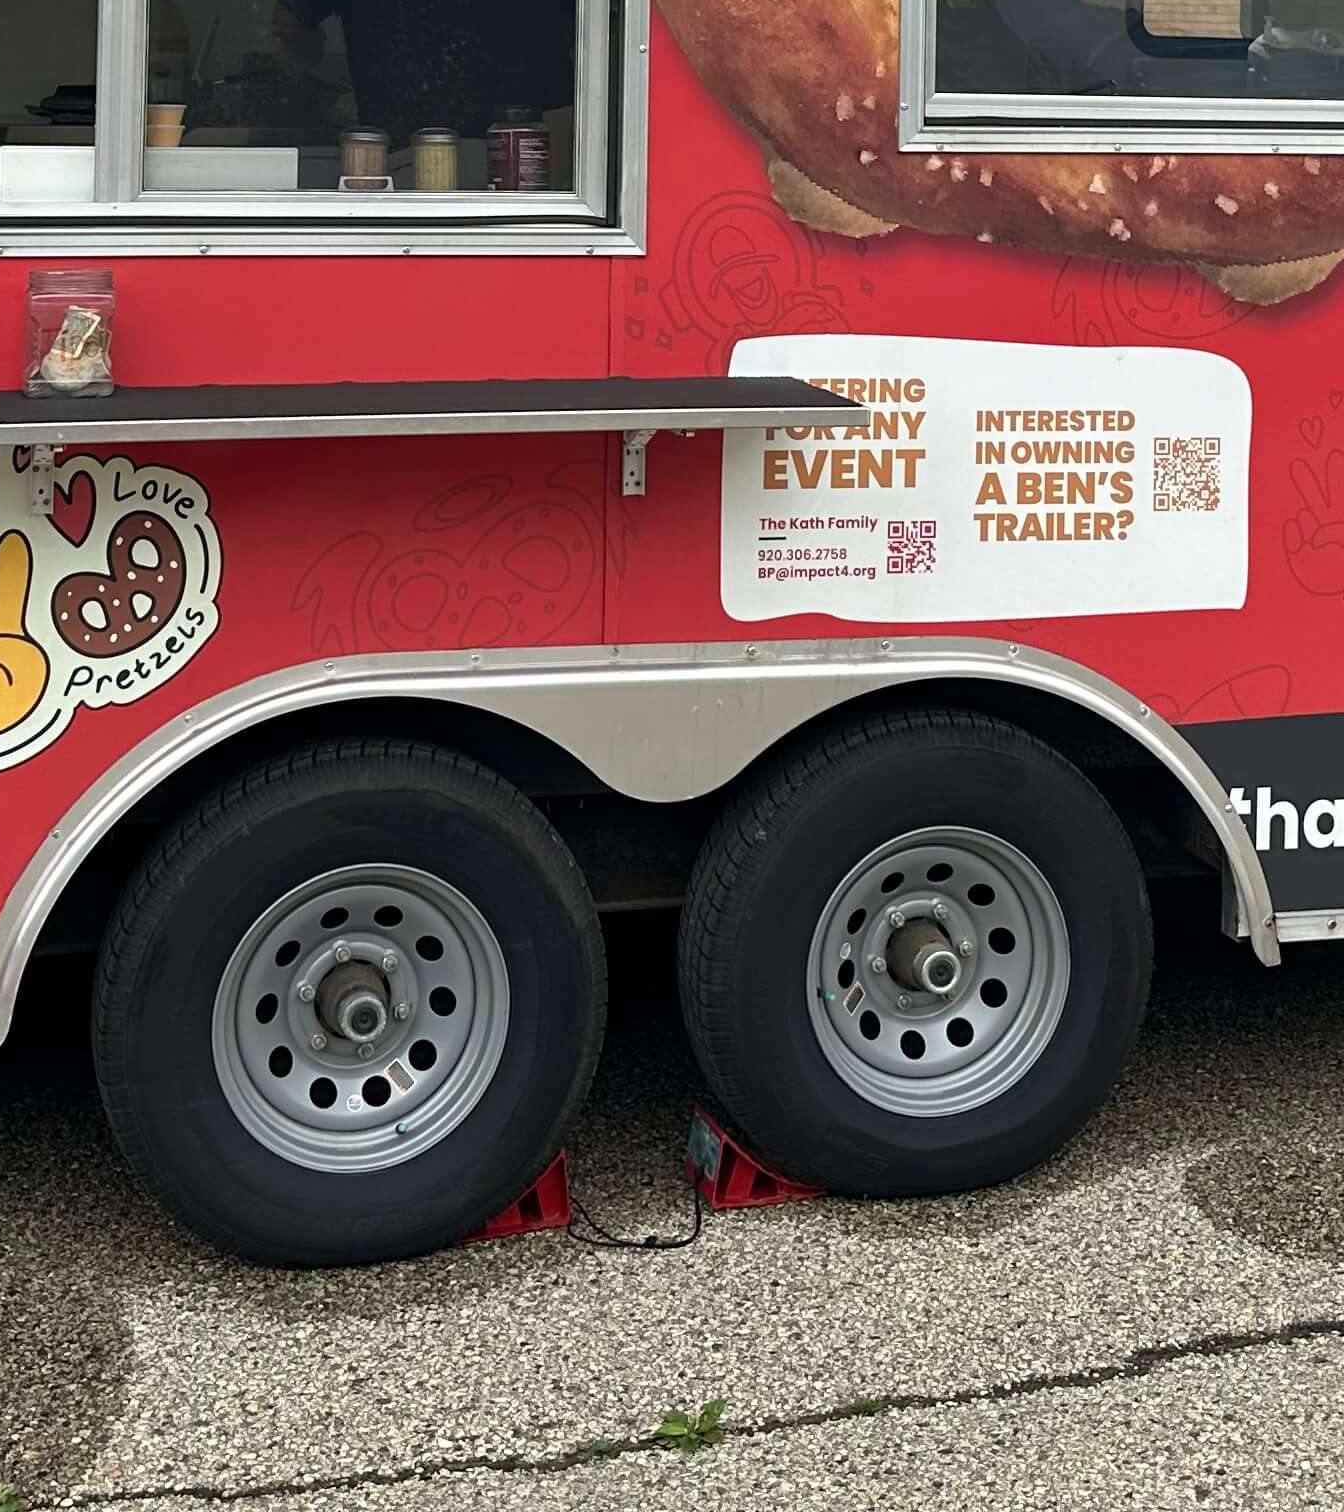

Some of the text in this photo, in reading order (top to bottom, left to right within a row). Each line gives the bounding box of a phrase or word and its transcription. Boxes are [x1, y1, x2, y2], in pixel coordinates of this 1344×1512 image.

[808, 377, 927, 404] ERING
[975, 409, 1136, 433] INTERESTED
[975, 440, 1136, 465] IN OWNING
[763, 448, 927, 490] EVENT
[112, 470, 195, 520] Love
[975, 470, 1134, 506] A BEN'S
[759, 515, 878, 533] The Kath Family
[973, 509, 1135, 543] TRAILER?
[757, 547, 848, 562] 920.306.2758
[757, 564, 877, 582] BP@impact4.org
[64, 606, 206, 697] Pretzels
